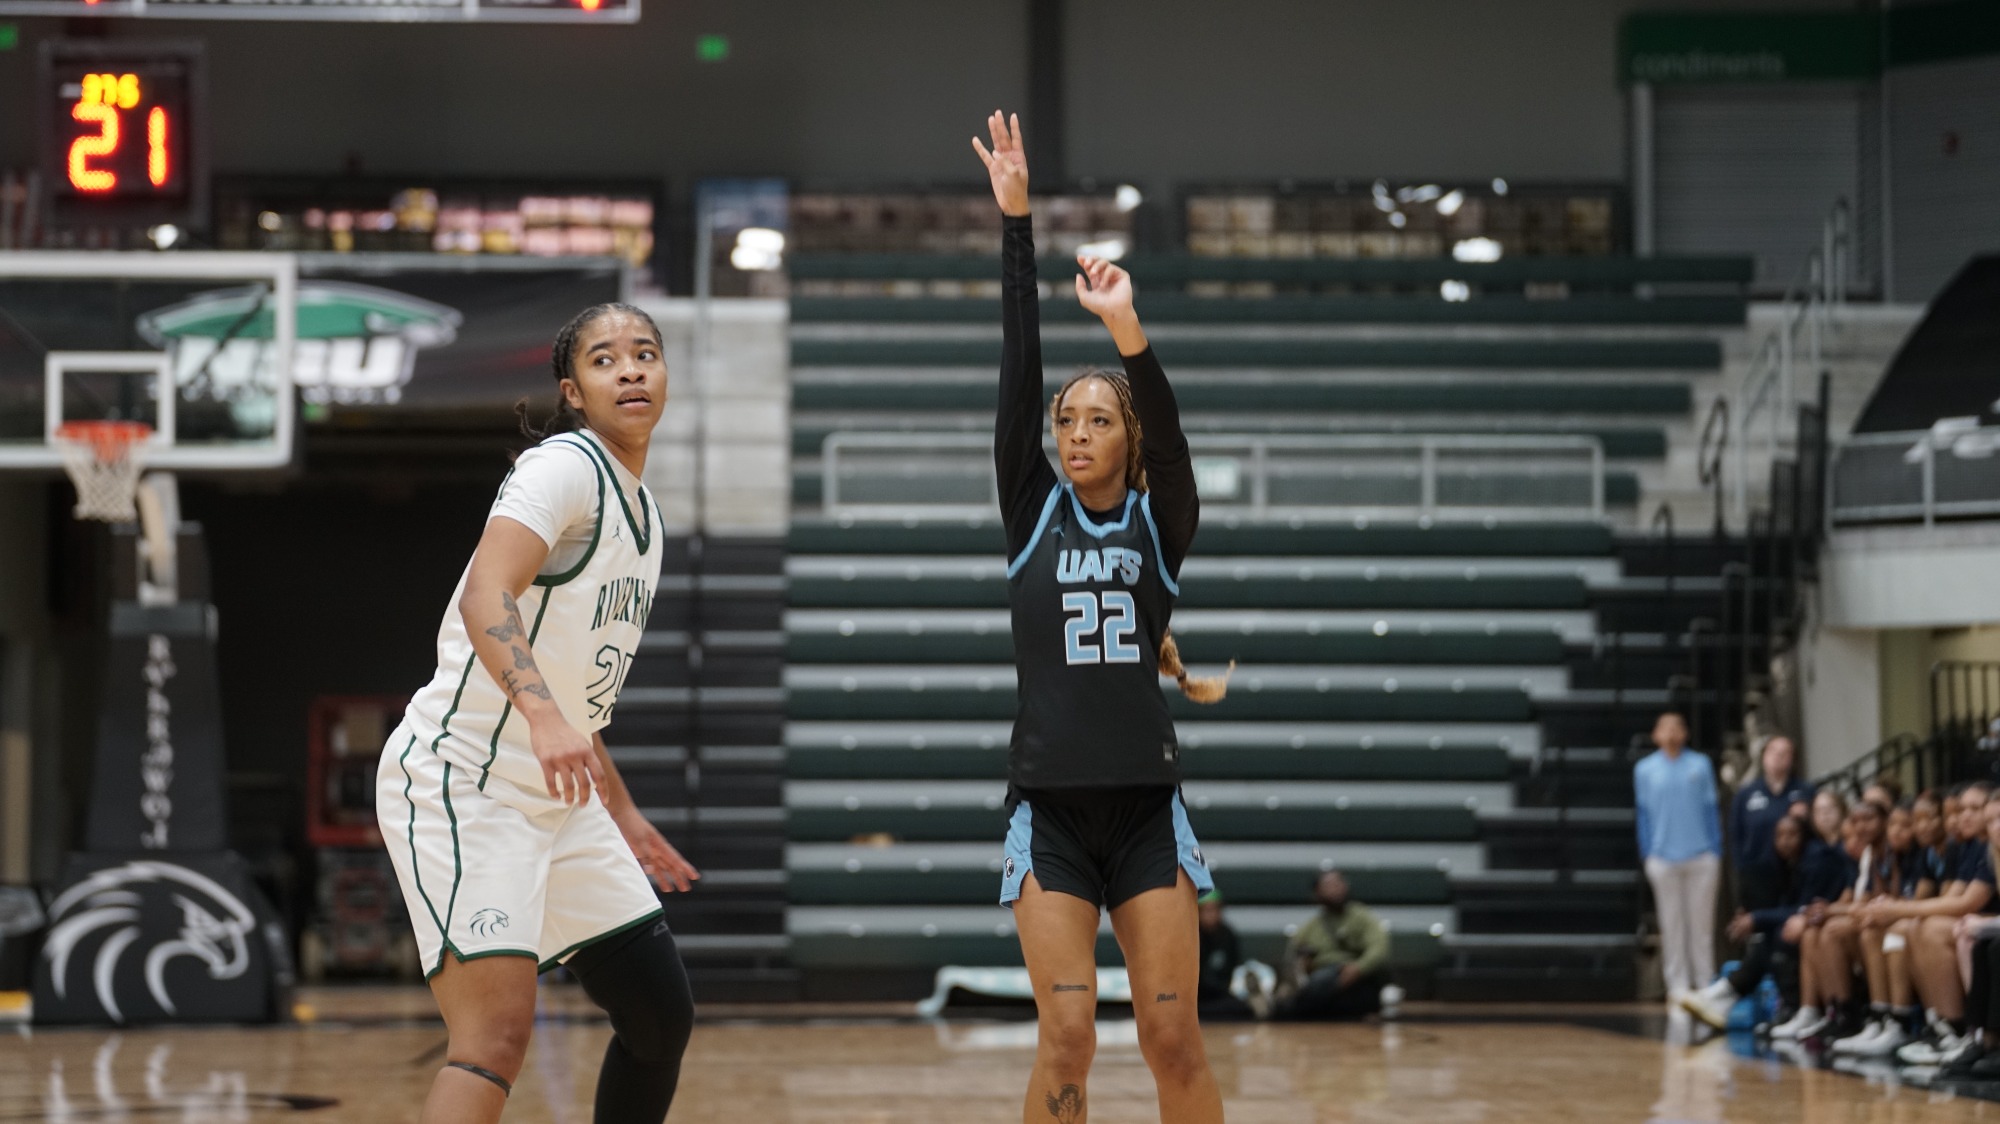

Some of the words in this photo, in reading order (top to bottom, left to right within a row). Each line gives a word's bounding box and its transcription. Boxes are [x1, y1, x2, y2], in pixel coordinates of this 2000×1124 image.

[68, 102, 168, 191] 21
[1056, 546, 1143, 586] UAFS
[1062, 590, 1141, 666] 22
